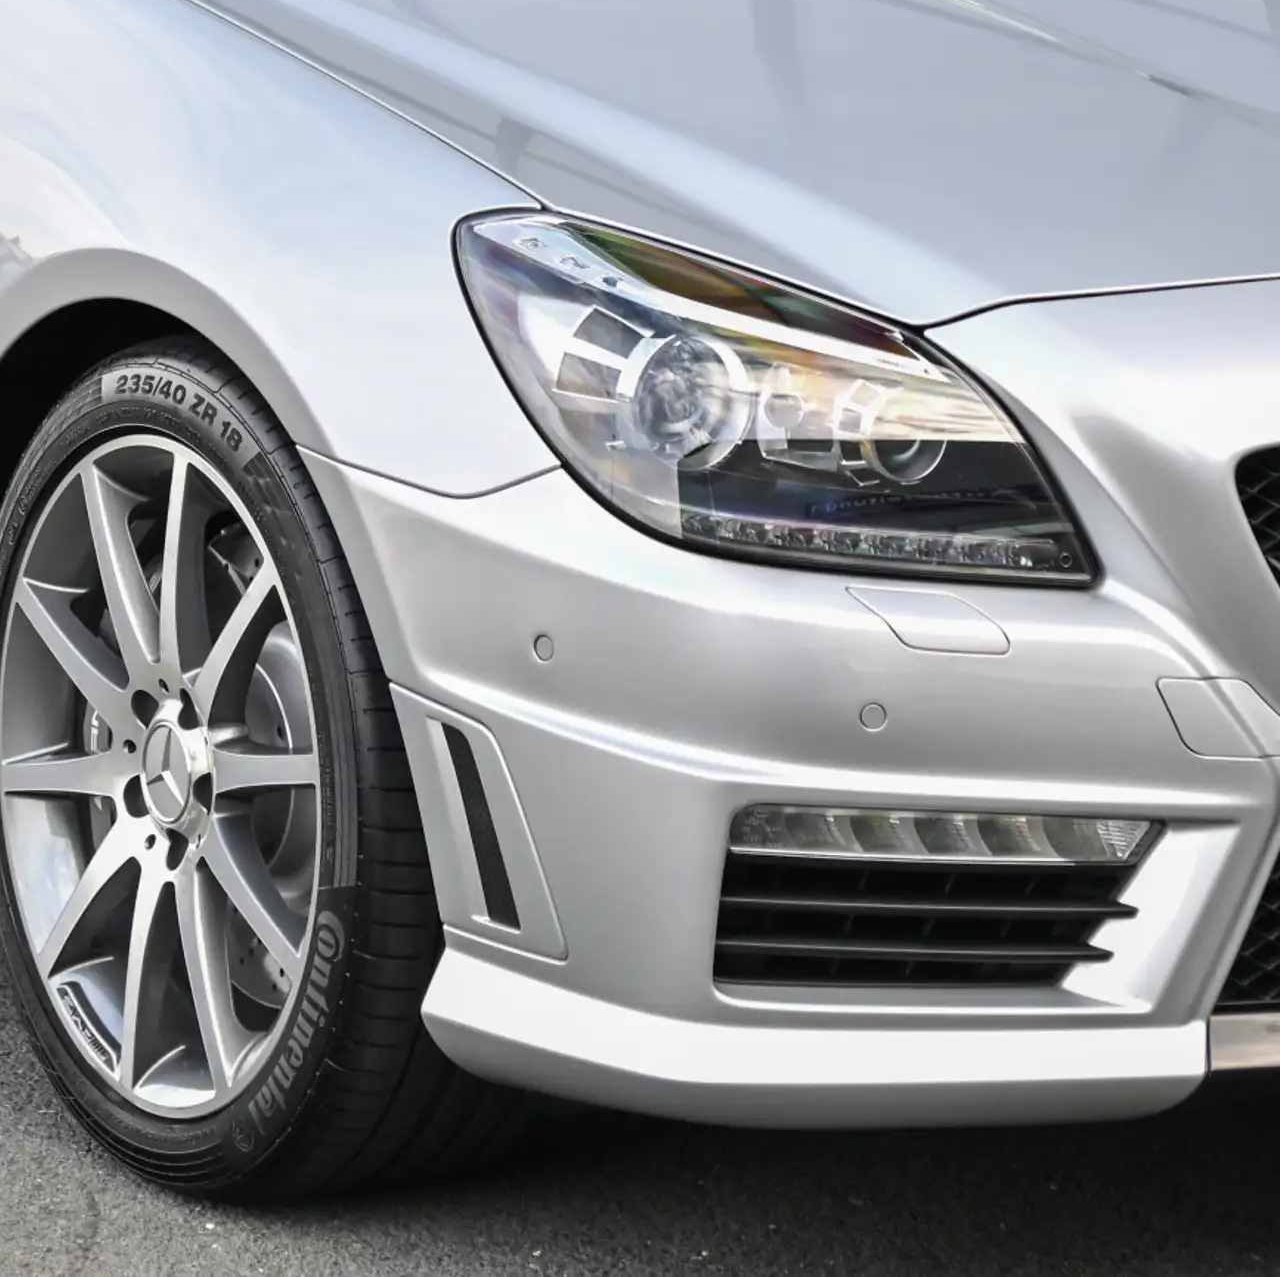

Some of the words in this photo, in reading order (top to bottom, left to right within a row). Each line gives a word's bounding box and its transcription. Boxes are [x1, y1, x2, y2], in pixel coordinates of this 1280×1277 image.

[115, 373, 187, 405] 235/40
[188, 393, 219, 427] ZR
[221, 420, 243, 452] 18
